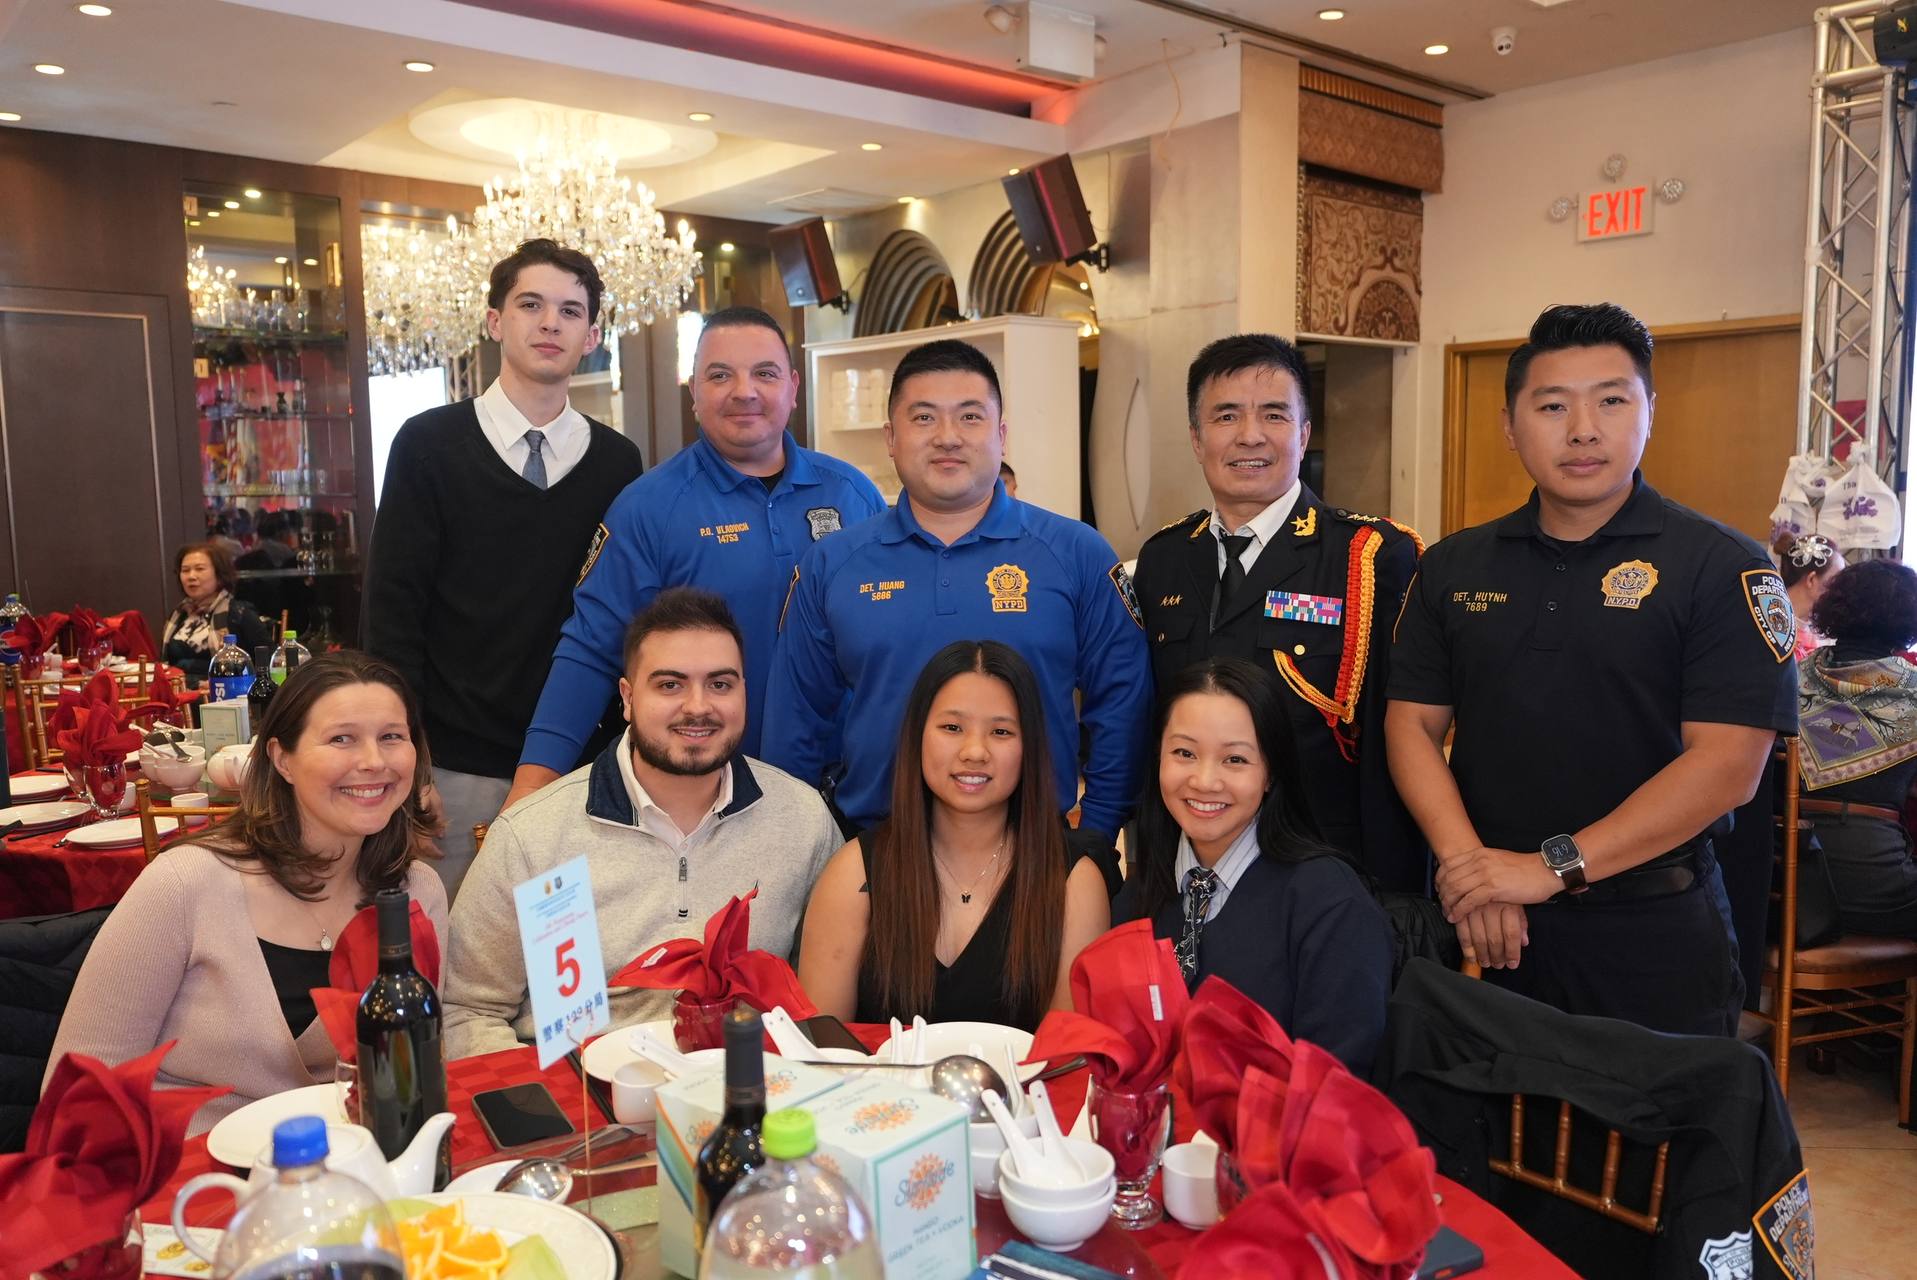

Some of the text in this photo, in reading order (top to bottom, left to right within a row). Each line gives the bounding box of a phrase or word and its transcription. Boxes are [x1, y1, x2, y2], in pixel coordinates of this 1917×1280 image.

[1587, 185, 1647, 237] EXIT
[717, 533, 739, 543] 14753
[859, 580, 905, 593] DET. HUANG
[1453, 591, 1508, 603] DET. HUYNH
[1465, 601, 1488, 612] 7689
[1754, 606, 1777, 644] CITY OF
[555, 936, 581, 997] 5
[1773, 1183, 1801, 1217] POLICE
